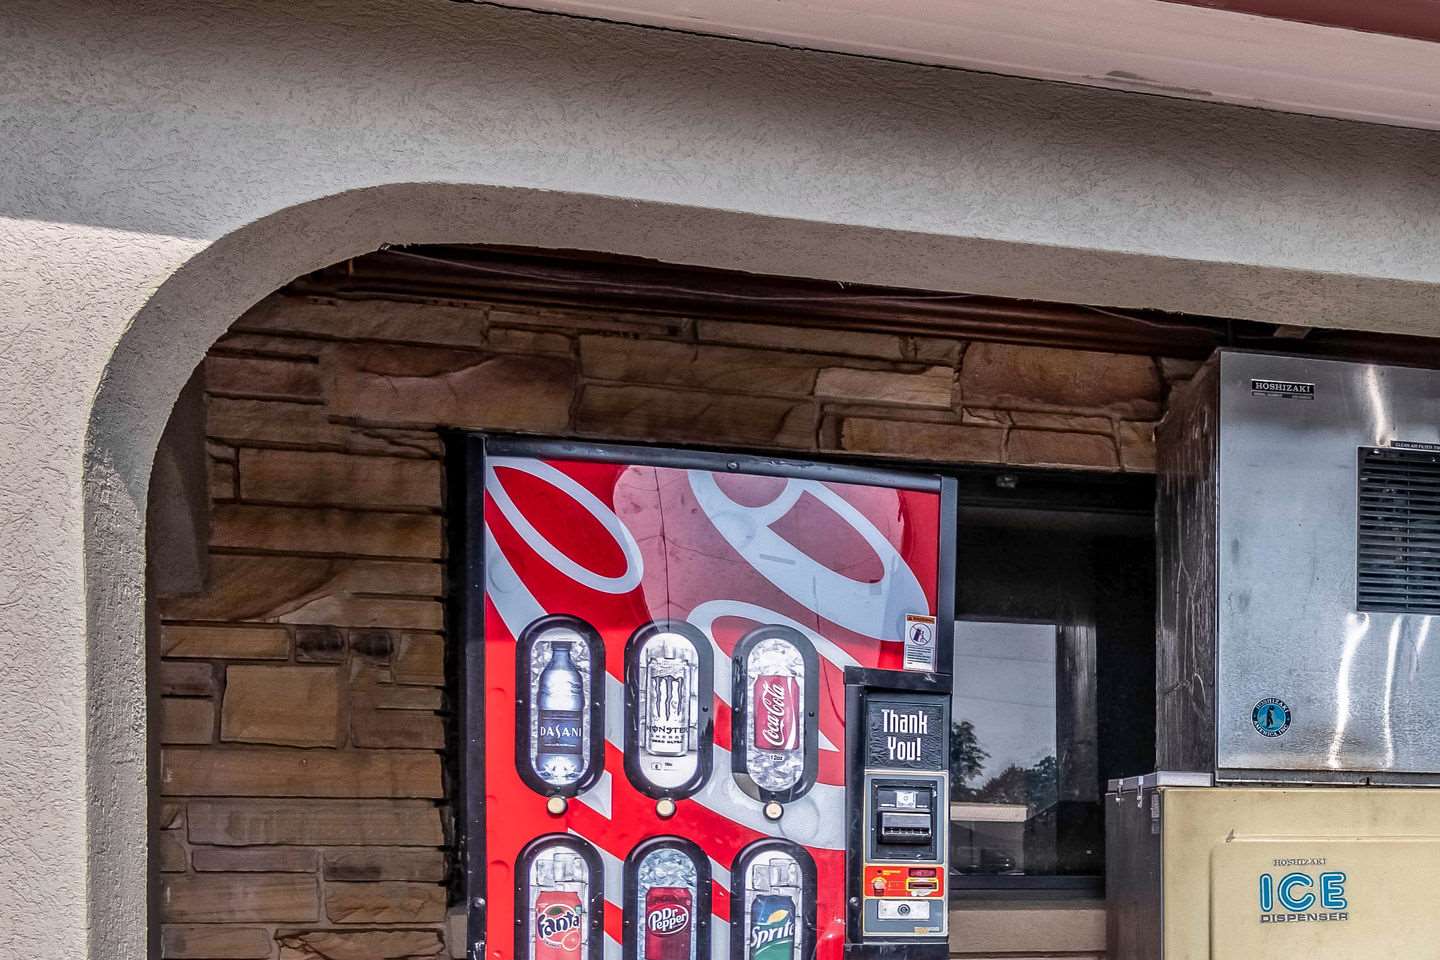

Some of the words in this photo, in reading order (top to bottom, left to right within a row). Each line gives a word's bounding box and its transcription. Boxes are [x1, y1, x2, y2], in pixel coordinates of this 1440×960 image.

[1256, 382, 1310, 393] HOSHIZAKI
[540, 725, 582, 738] DASANI
[881, 709, 928, 734] Thank
[887, 736, 921, 761] You!
[1273, 858, 1326, 867] HOSHIZAKI
[1259, 872, 1348, 912] ICE
[652, 911, 686, 931] Pepper
[662, 907, 678, 921] Dr
[1259, 912, 1349, 923] DISPENSER
[537, 912, 580, 939] Fanta
[750, 919, 794, 949] Sprite
